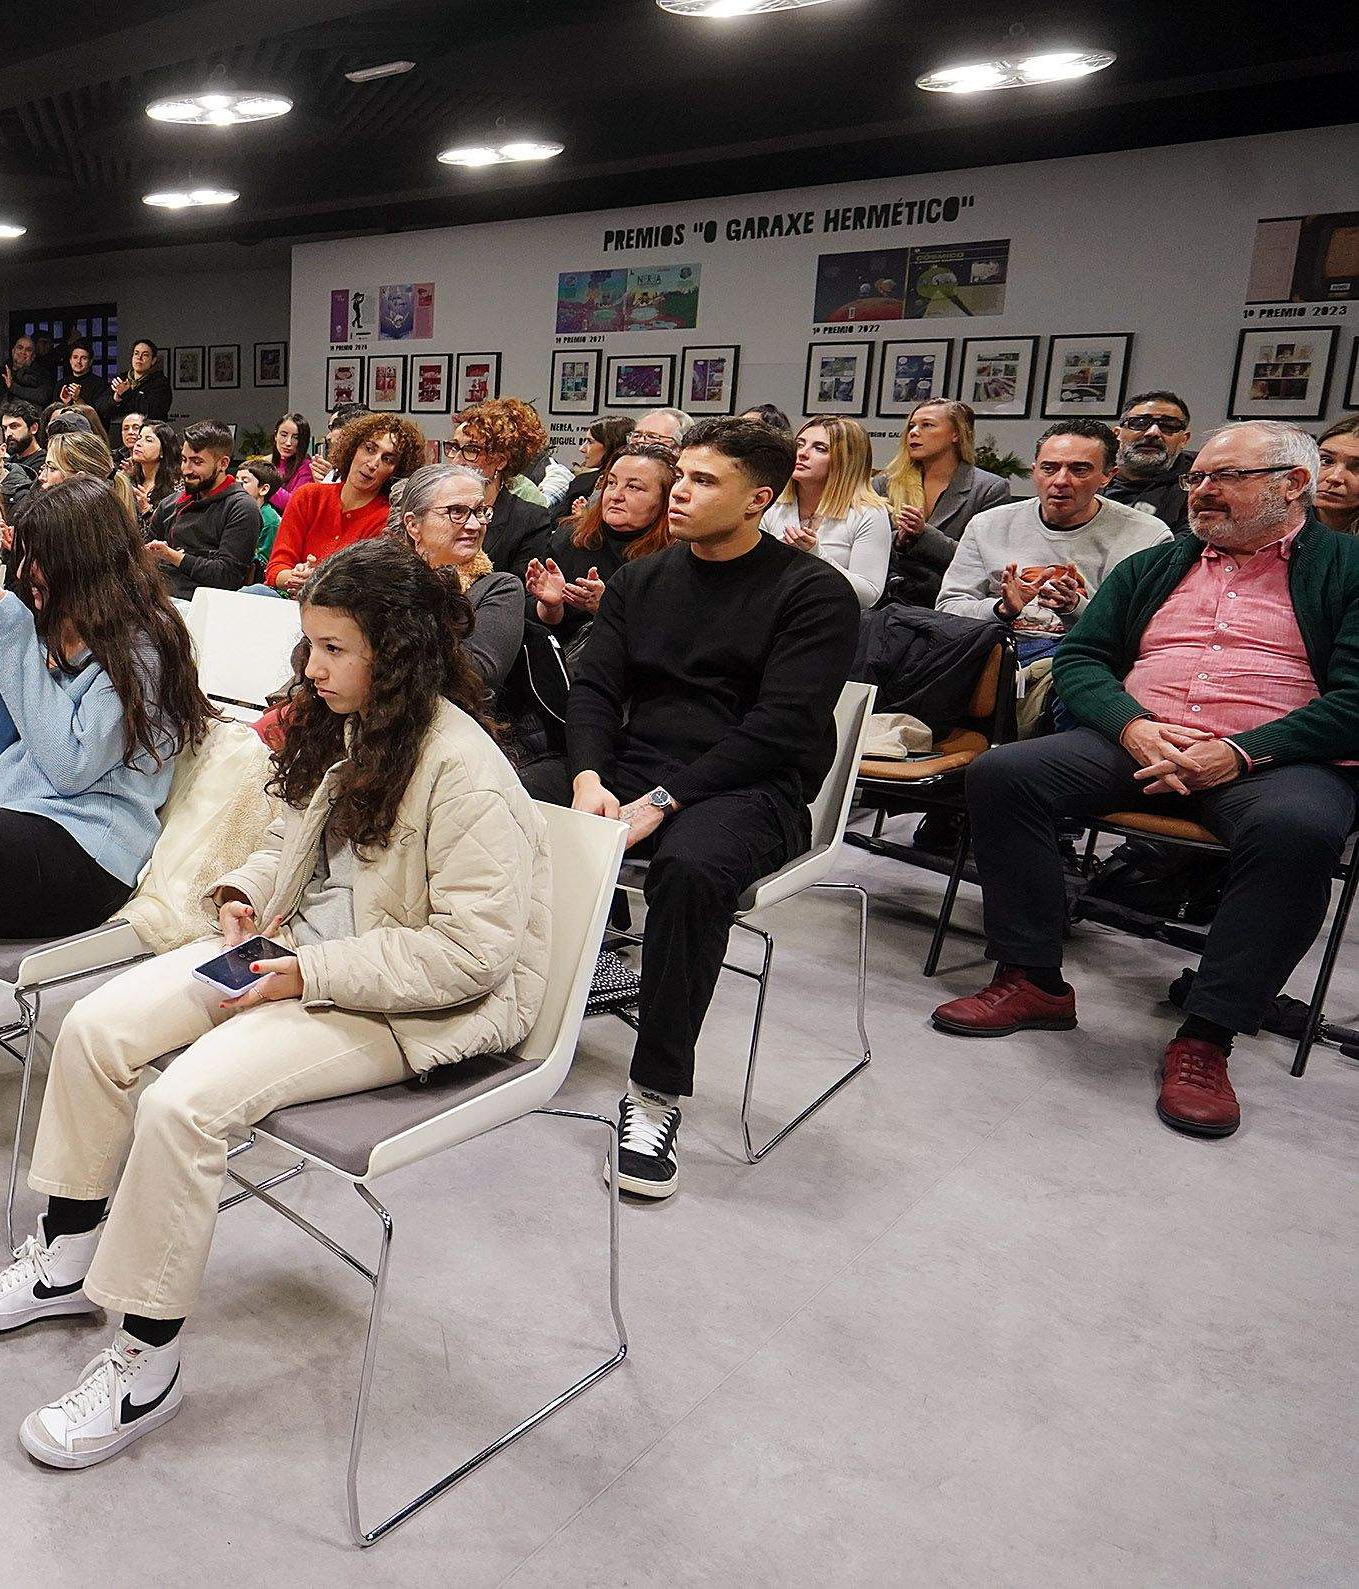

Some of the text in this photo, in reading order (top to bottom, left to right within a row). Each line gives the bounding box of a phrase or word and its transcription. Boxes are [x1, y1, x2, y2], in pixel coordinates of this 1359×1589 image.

[603, 195, 976, 251] PREMIOS "O GARAXE HERMÉTICO"
[1259, 307, 1307, 319] PREMIO
[1312, 305, 1348, 317] 2023
[823, 325, 854, 335] PREMIO
[563, 335, 586, 343] PREMIO
[550, 422, 574, 432] NEREA,
[550, 436, 577, 446] MIGUEL
